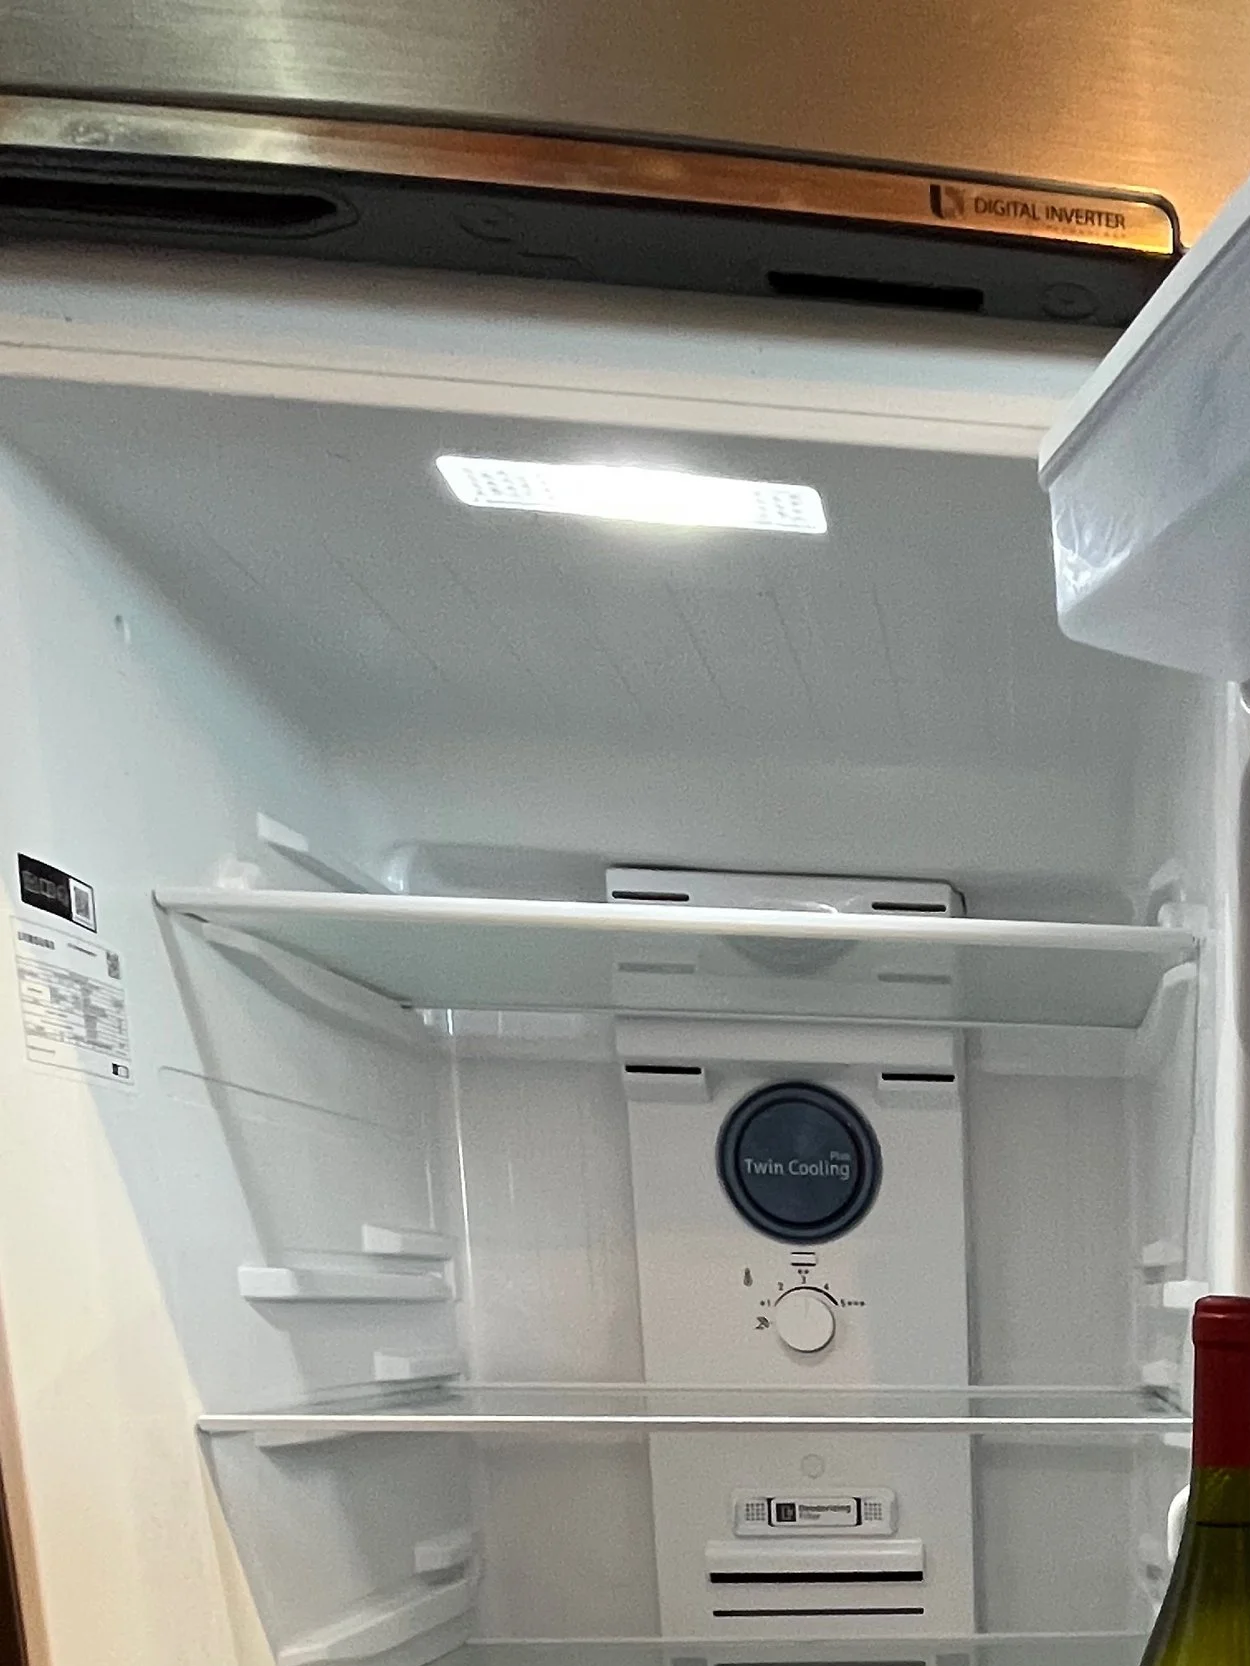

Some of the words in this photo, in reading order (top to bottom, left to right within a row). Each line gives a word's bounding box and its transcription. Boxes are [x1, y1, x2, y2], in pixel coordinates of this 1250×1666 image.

[973, 196, 1040, 221] DIGITAL
[1045, 205, 1126, 229] INVERTER
[744, 1158, 784, 1176] Twin
[788, 1158, 850, 1180] Cooling
